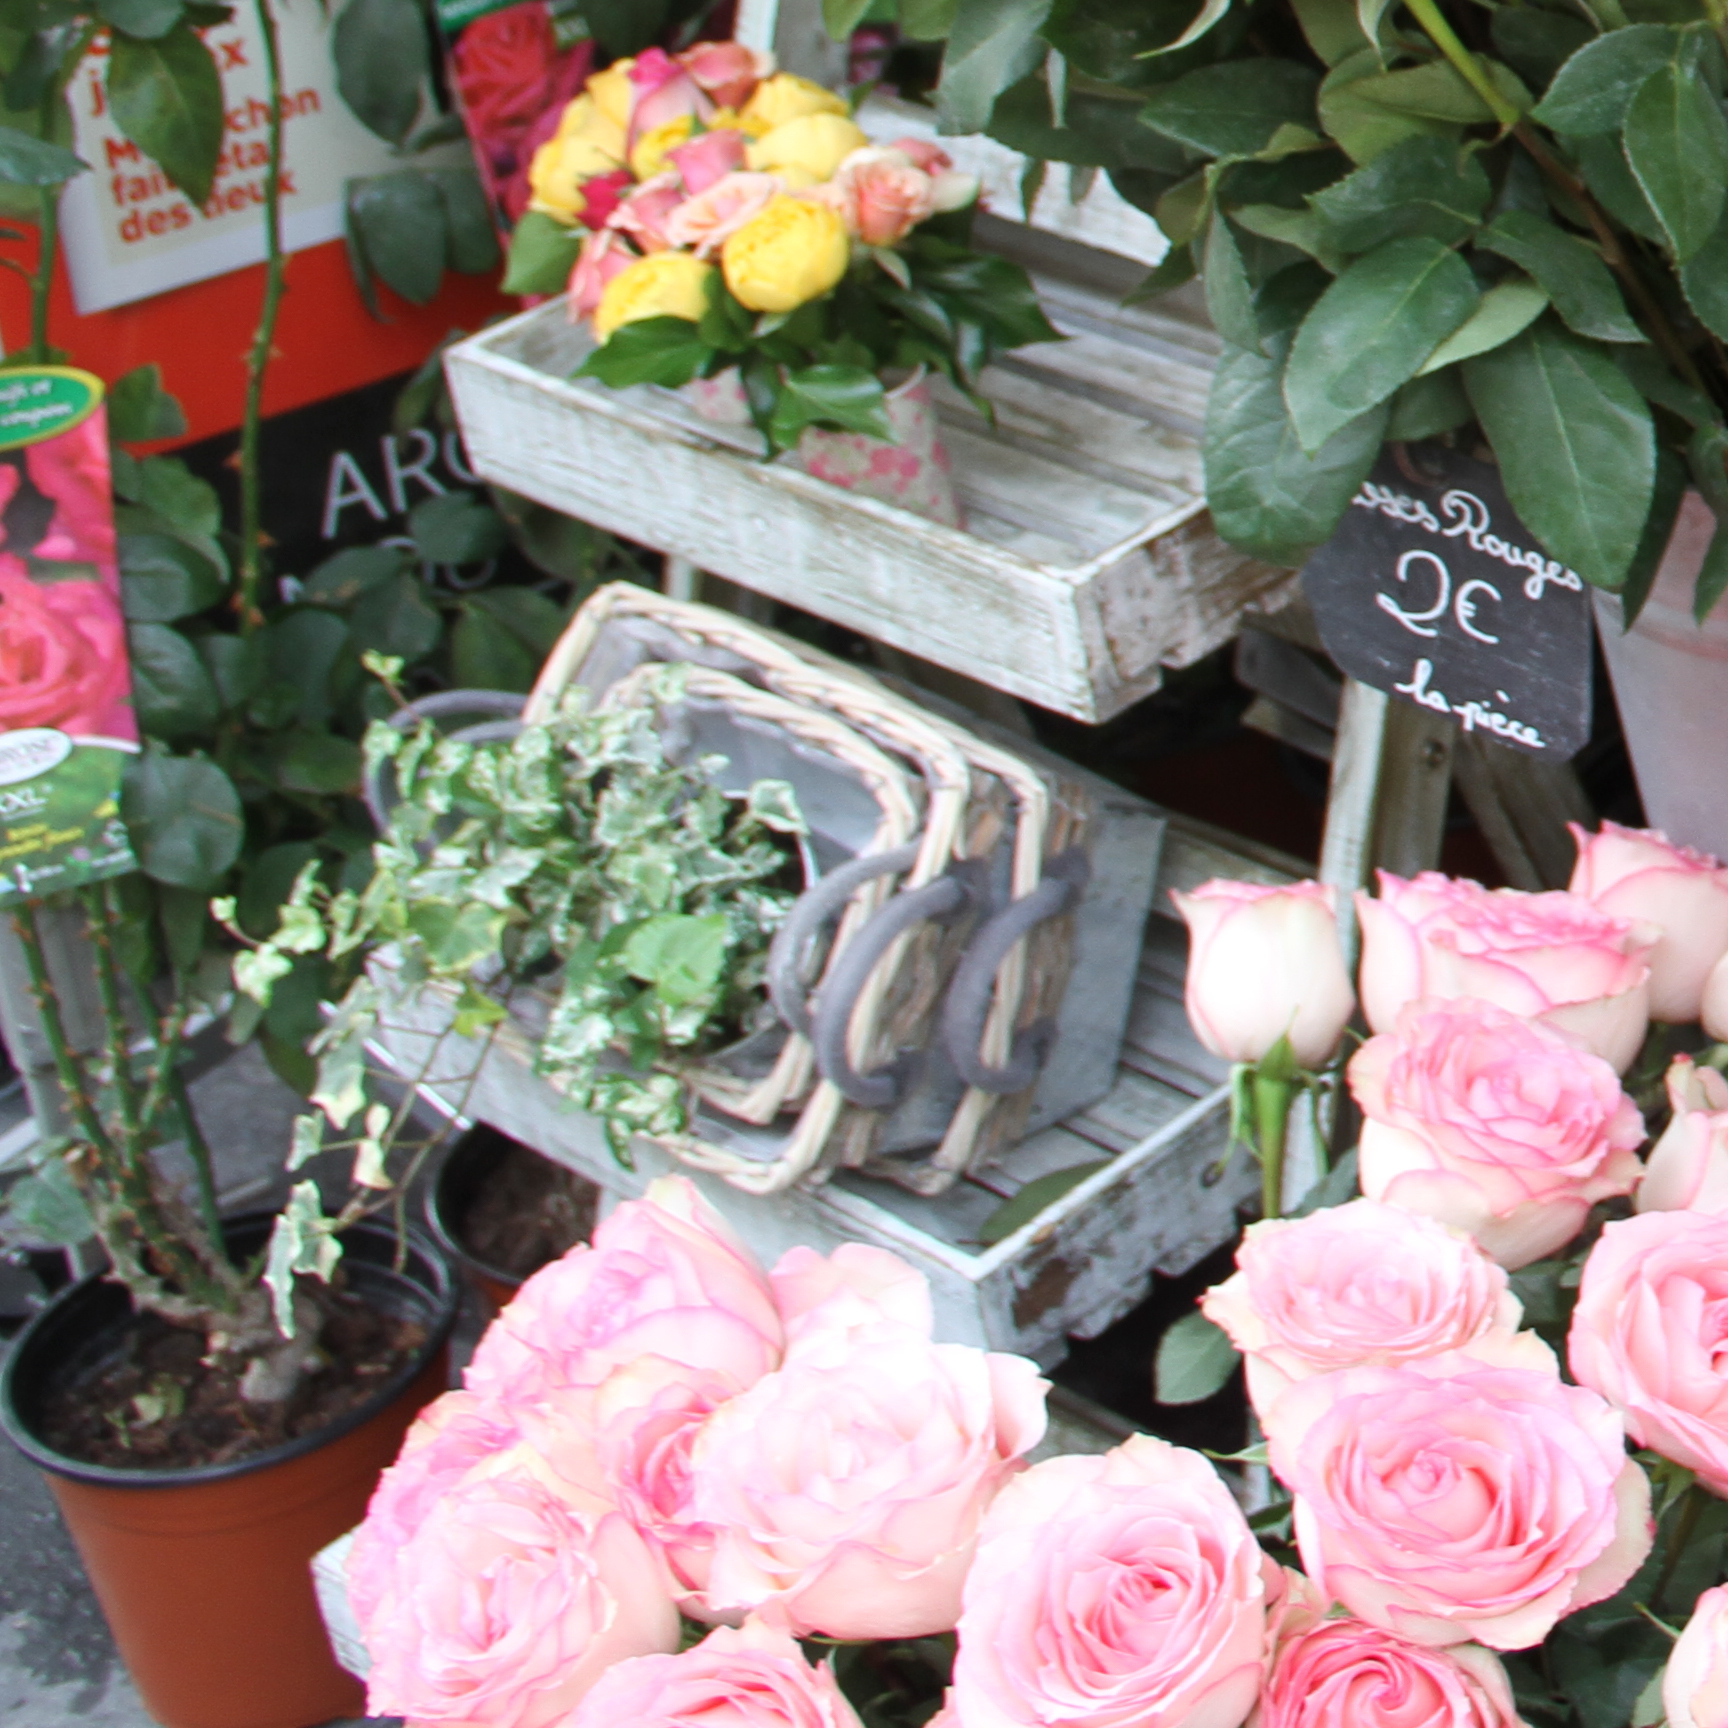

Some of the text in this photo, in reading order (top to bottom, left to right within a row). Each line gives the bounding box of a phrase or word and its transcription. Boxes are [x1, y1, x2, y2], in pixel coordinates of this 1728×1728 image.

[117, 201, 193, 244] des
[1441, 488, 1584, 601] Rouges
[1374, 549, 1502, 646] 2€
[1392, 657, 1547, 749] la pièce
